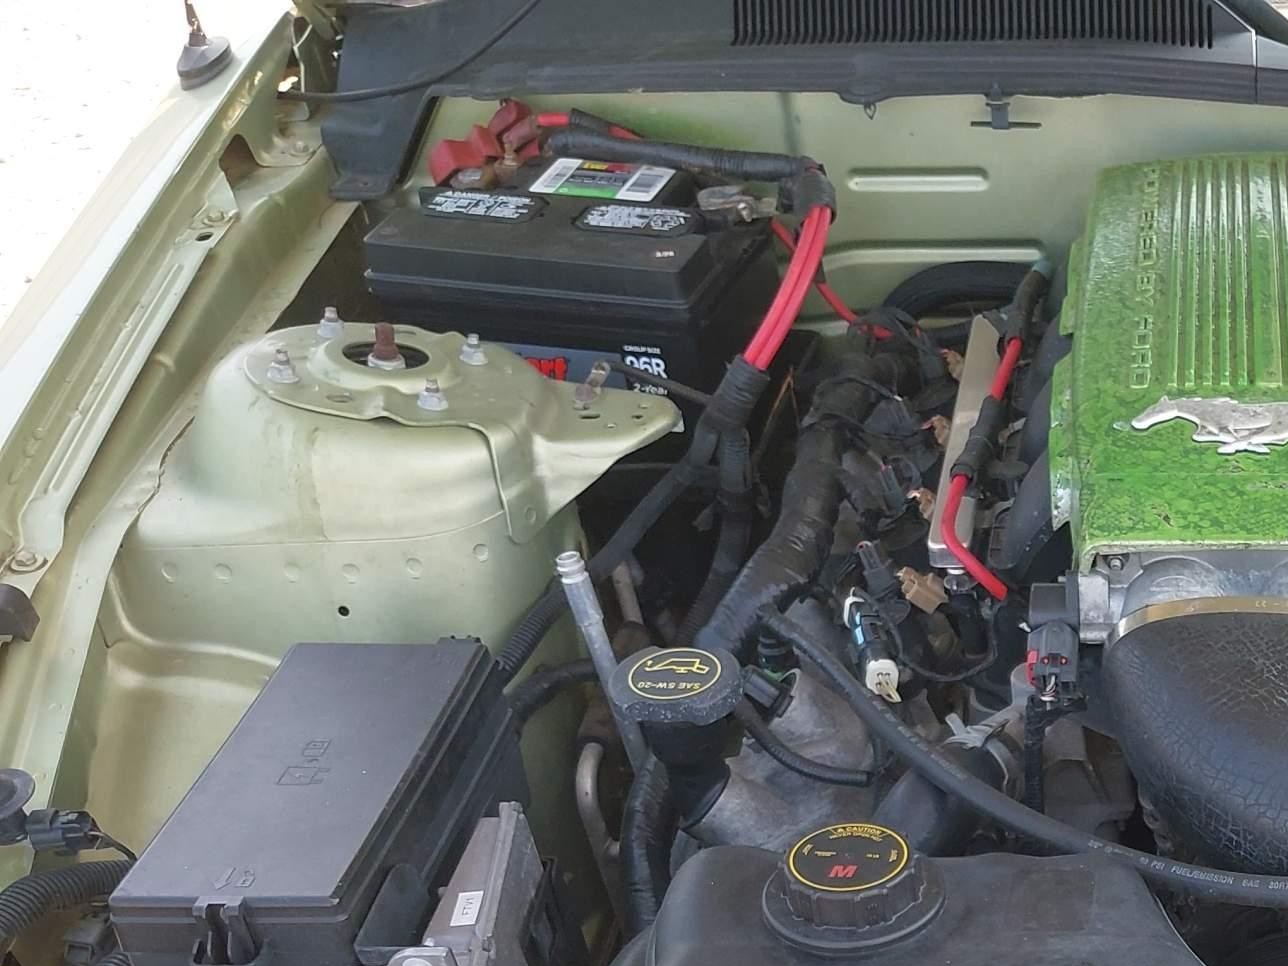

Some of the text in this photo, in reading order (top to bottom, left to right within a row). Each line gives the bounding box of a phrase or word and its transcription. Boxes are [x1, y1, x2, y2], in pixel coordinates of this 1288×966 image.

[1129, 167, 1161, 390] POWERED BY FORD
[638, 681, 702, 690] SAE 5W-20
[846, 826, 882, 836] CAUTION
